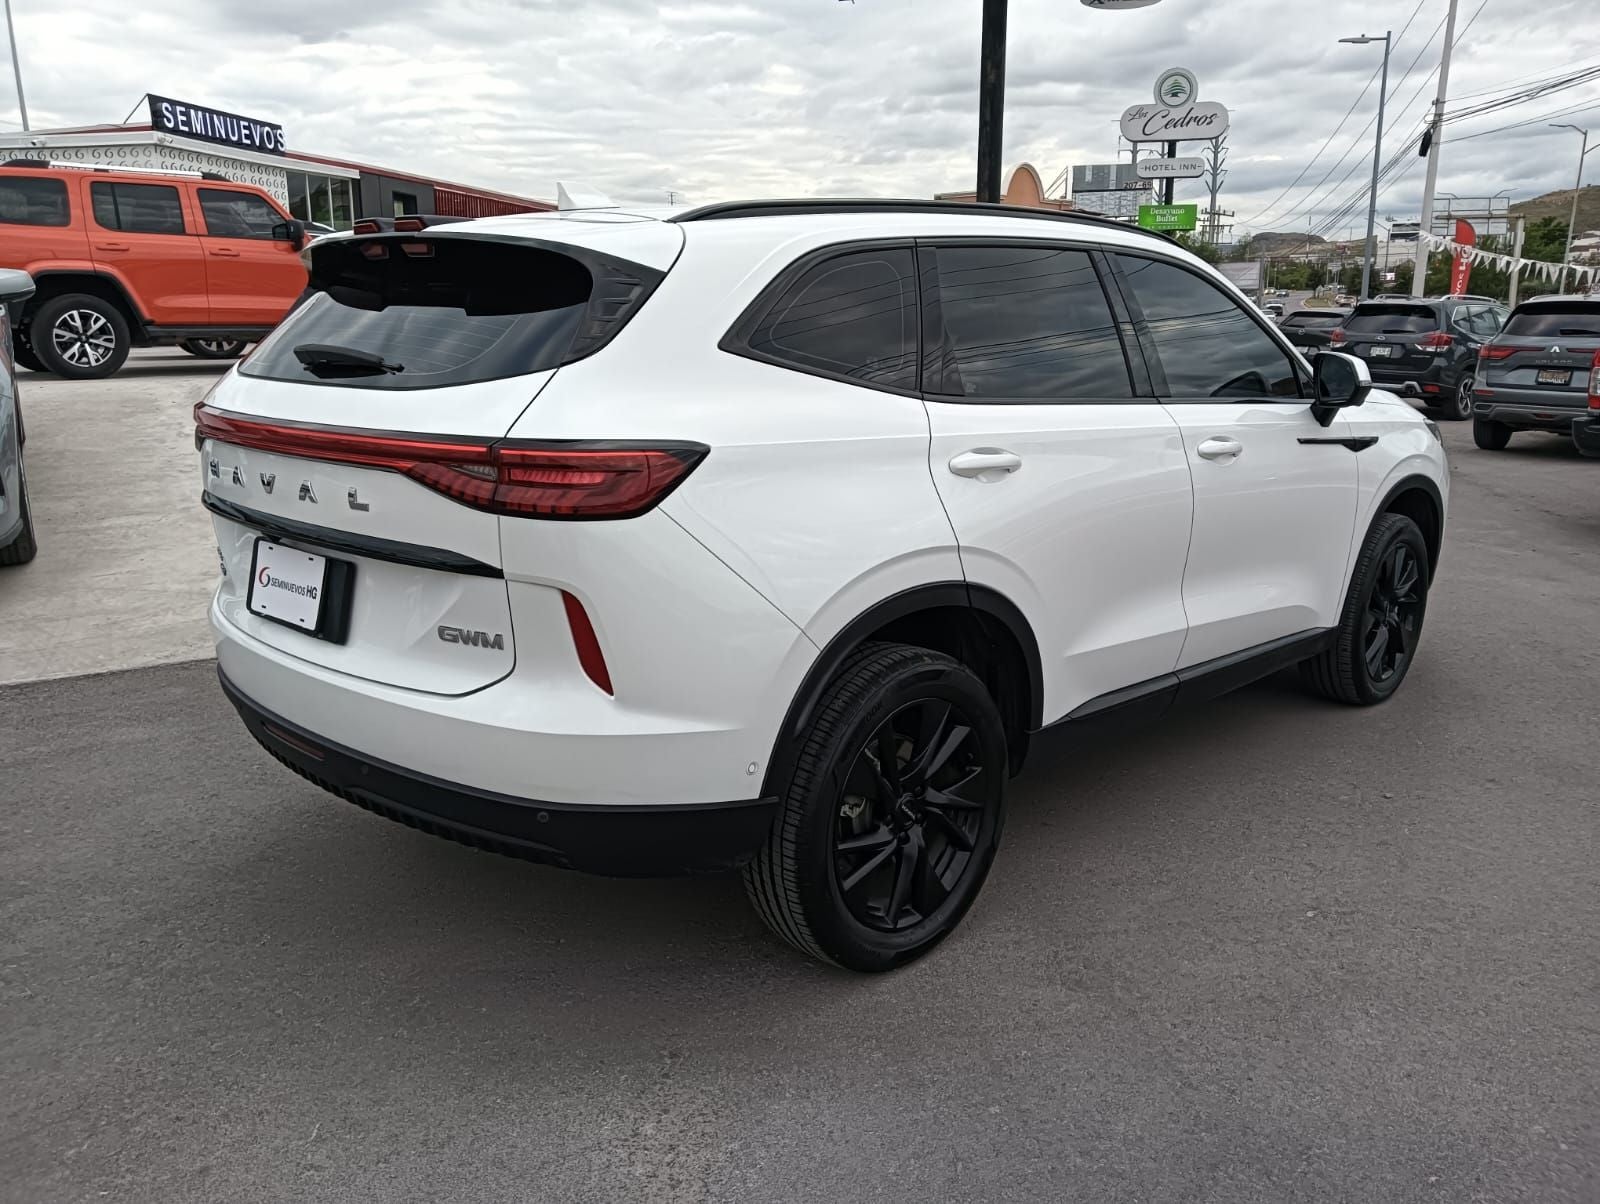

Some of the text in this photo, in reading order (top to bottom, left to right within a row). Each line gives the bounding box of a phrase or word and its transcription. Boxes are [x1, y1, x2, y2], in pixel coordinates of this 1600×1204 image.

[161, 102, 286, 151] SEMINUEVOS
[1142, 107, 1218, 136] Cedros
[1144, 164, 1176, 172] HOTEL
[270, 577, 318, 600] SEMINUEVOS HG
[437, 625, 504, 651] GWM
